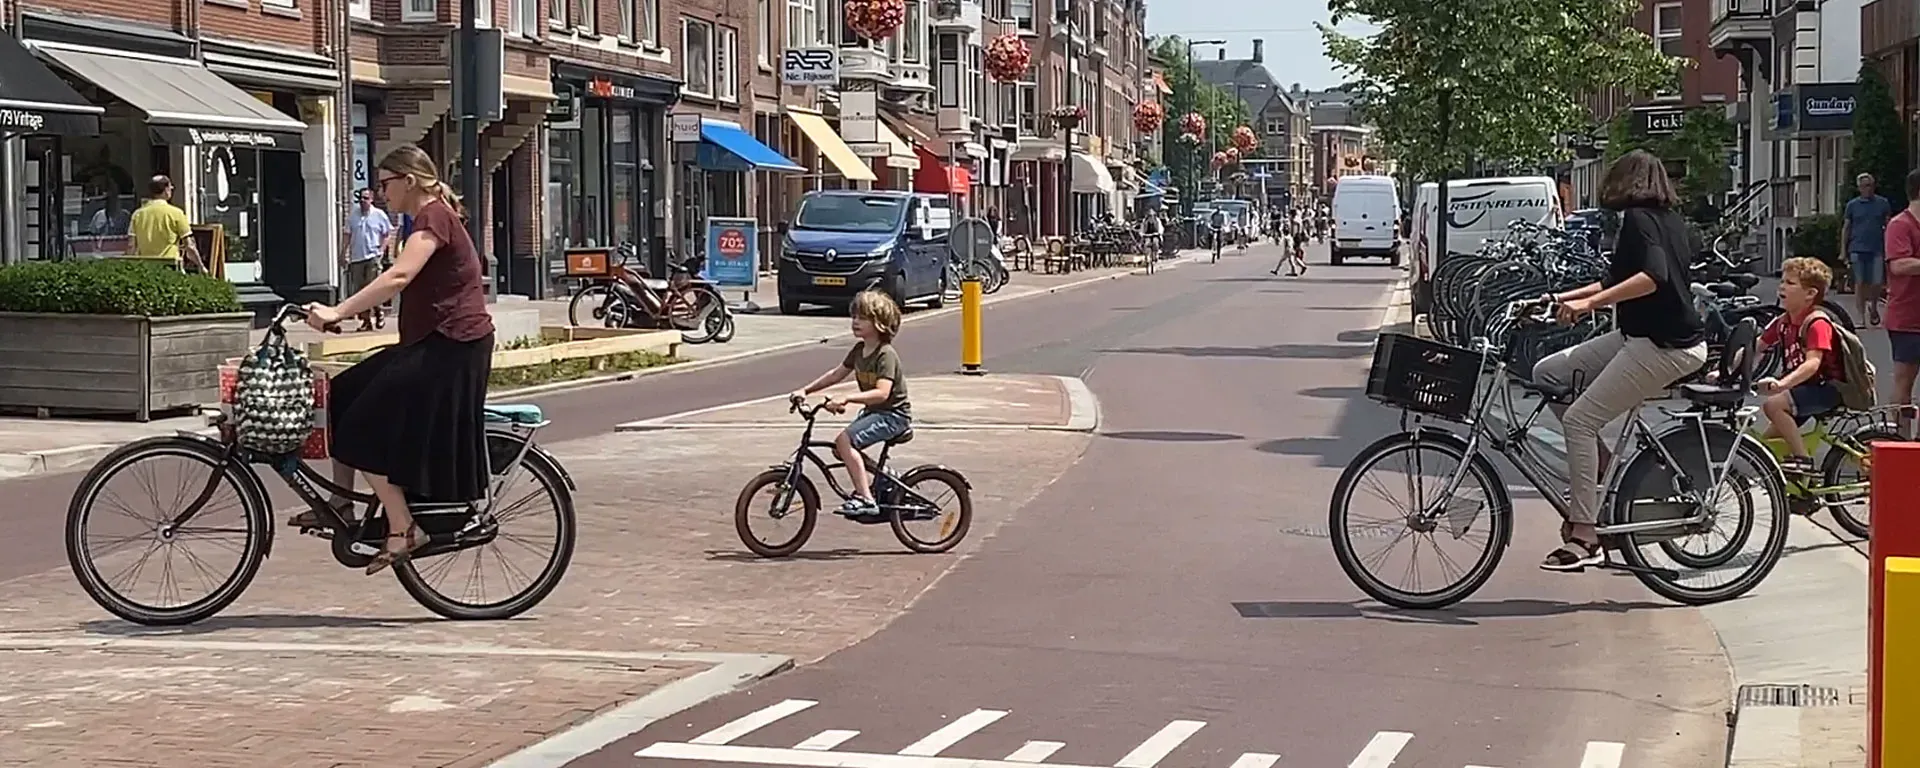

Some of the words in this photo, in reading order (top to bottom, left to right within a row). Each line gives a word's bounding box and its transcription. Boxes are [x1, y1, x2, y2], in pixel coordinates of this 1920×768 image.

[13, 110, 44, 131] Vintage
[675, 122, 698, 131] huid
[1647, 114, 1683, 128] leuk!
[1433, 199, 1549, 212] RSTENRETAIL
[720, 236, 745, 248] 70%
